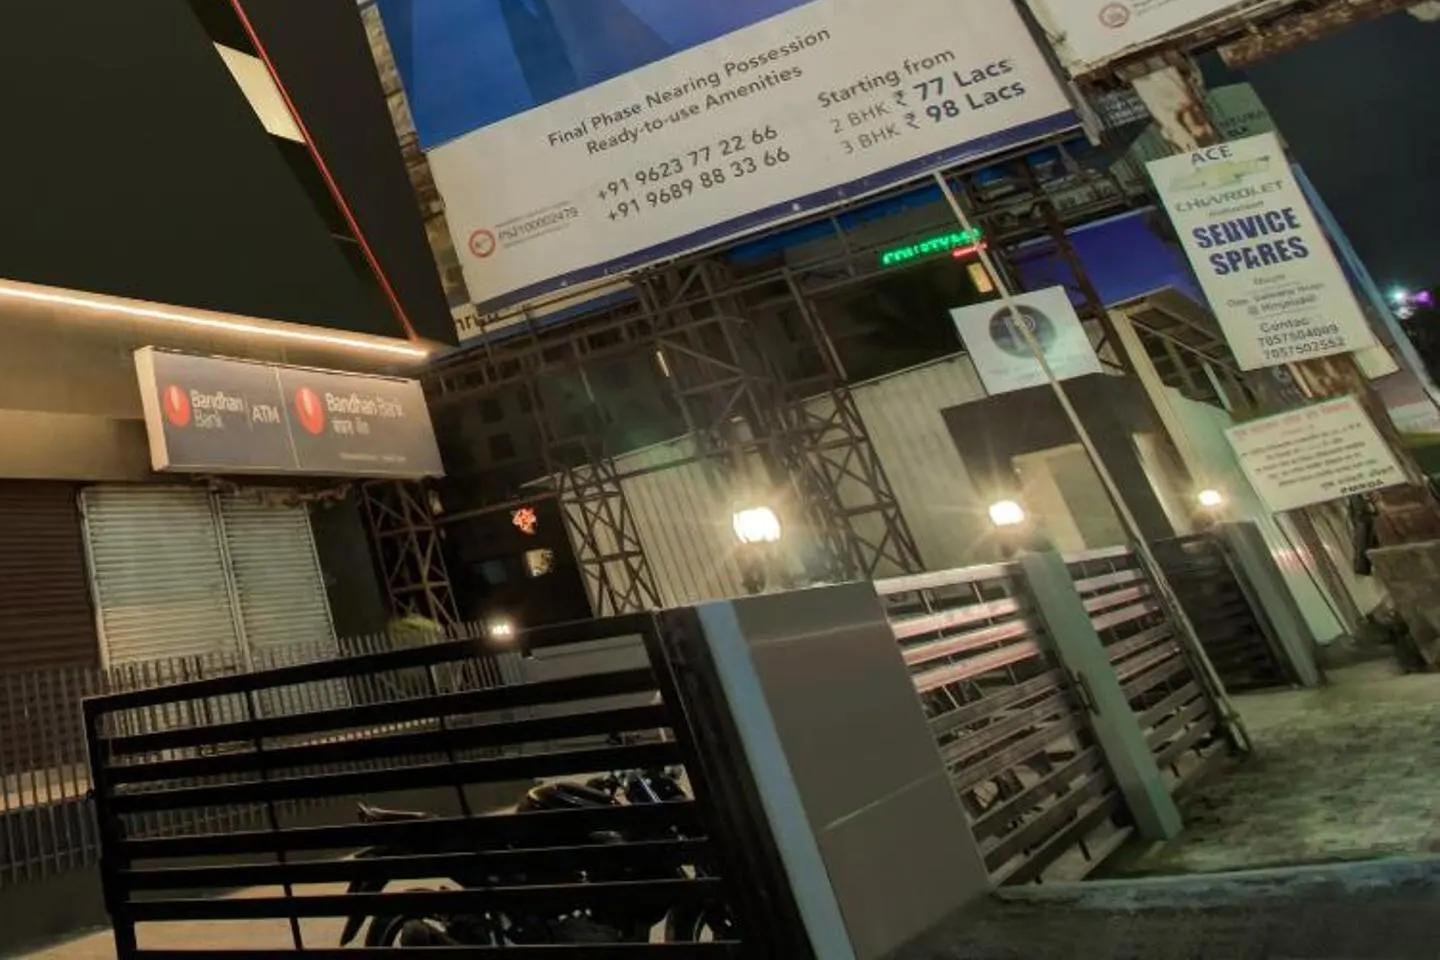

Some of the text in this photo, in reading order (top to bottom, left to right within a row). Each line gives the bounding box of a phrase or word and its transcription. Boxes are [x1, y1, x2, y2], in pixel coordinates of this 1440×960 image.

[548, 27, 831, 147] Final Phase Nearing Possession
[586, 64, 803, 155] Ready-to-use Amenities
[817, 49, 956, 108] Starting from
[830, 118, 843, 134] 2
[847, 101, 891, 127] BHK
[912, 76, 944, 101] 77
[953, 58, 1014, 88] Lacs
[841, 139, 854, 155] 3
[858, 123, 901, 149] BHK
[925, 100, 960, 123] 98
[965, 81, 1026, 110] Lacs
[1191, 144, 1233, 166] ACE
[598, 124, 778, 200] +91 9623 77 22 66
[609, 146, 791, 221] +91 9689 88 33 66
[1209, 236, 1310, 275] SPARES
[191, 390, 244, 413] Bandhan
[252, 405, 281, 424] ATM
